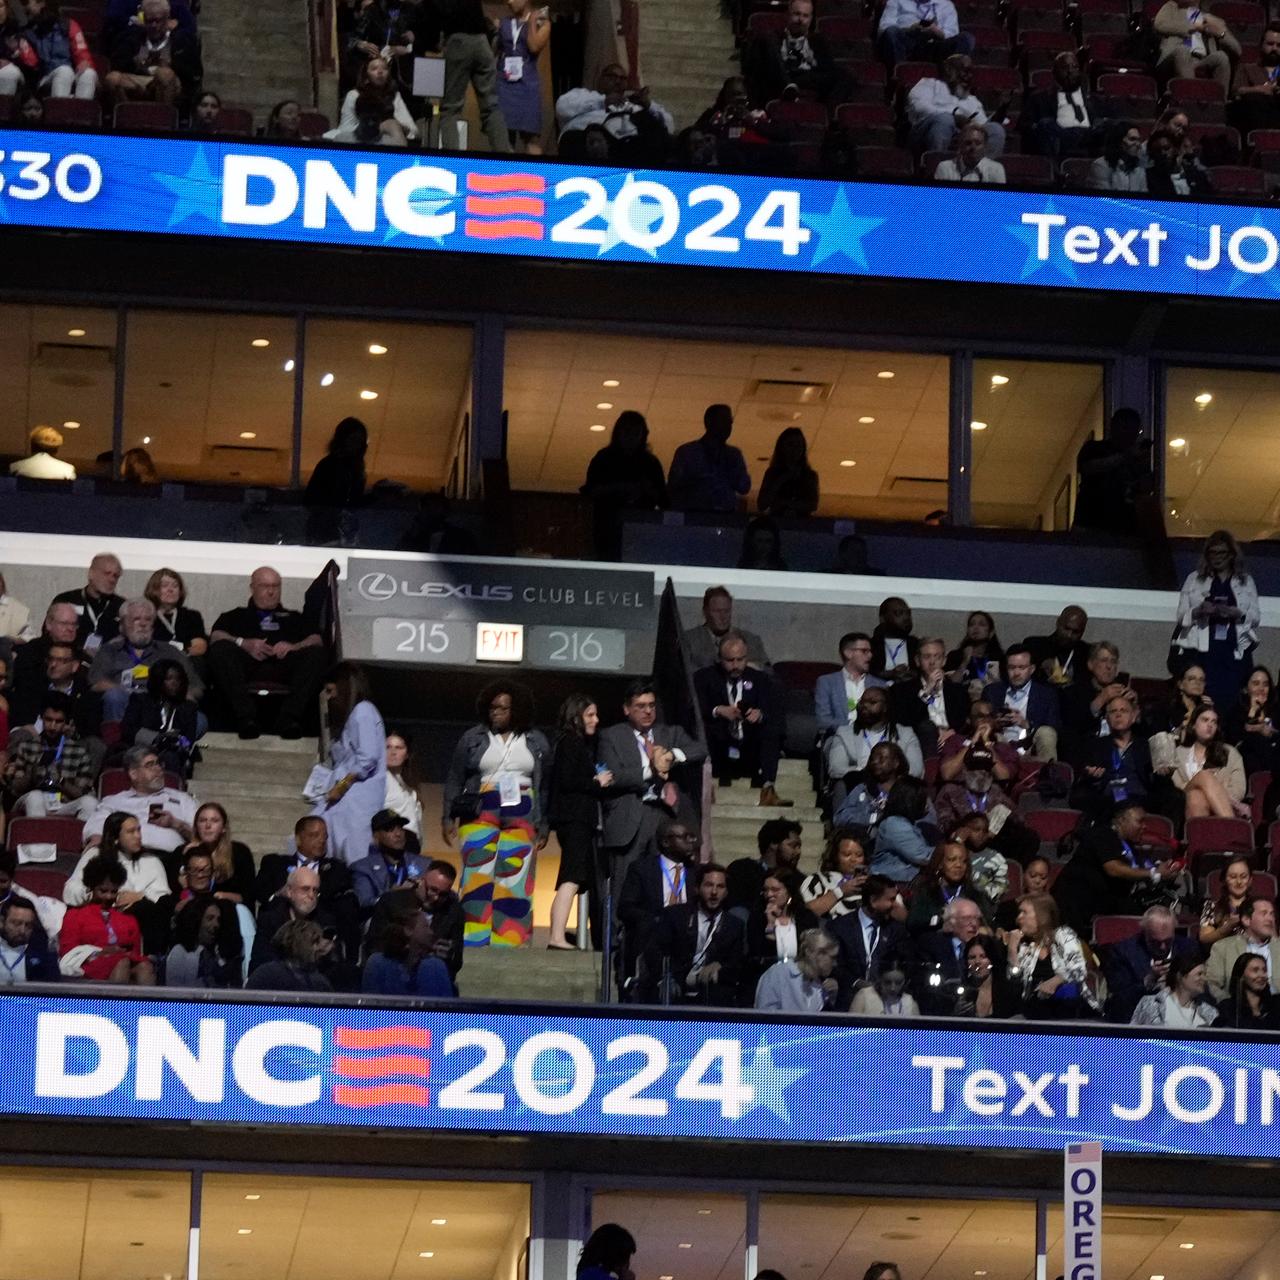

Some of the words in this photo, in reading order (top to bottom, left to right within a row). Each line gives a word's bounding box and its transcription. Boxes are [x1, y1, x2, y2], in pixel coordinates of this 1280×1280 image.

[0, 150, 102, 203] 30
[221, 154, 457, 238] DNC
[551, 173, 811, 258] 2024
[1021, 213, 1168, 267] Text
[401, 580, 514, 601] LEXUS
[522, 587, 575, 604] CLUB
[584, 591, 644, 608] LEVEL
[396, 623, 449, 653] 215
[482, 630, 519, 649] EXIT
[549, 631, 602, 661] 216
[34, 1011, 324, 1108] DNC
[437, 1027, 757, 1120] 2024
[911, 1055, 1090, 1119] Text
